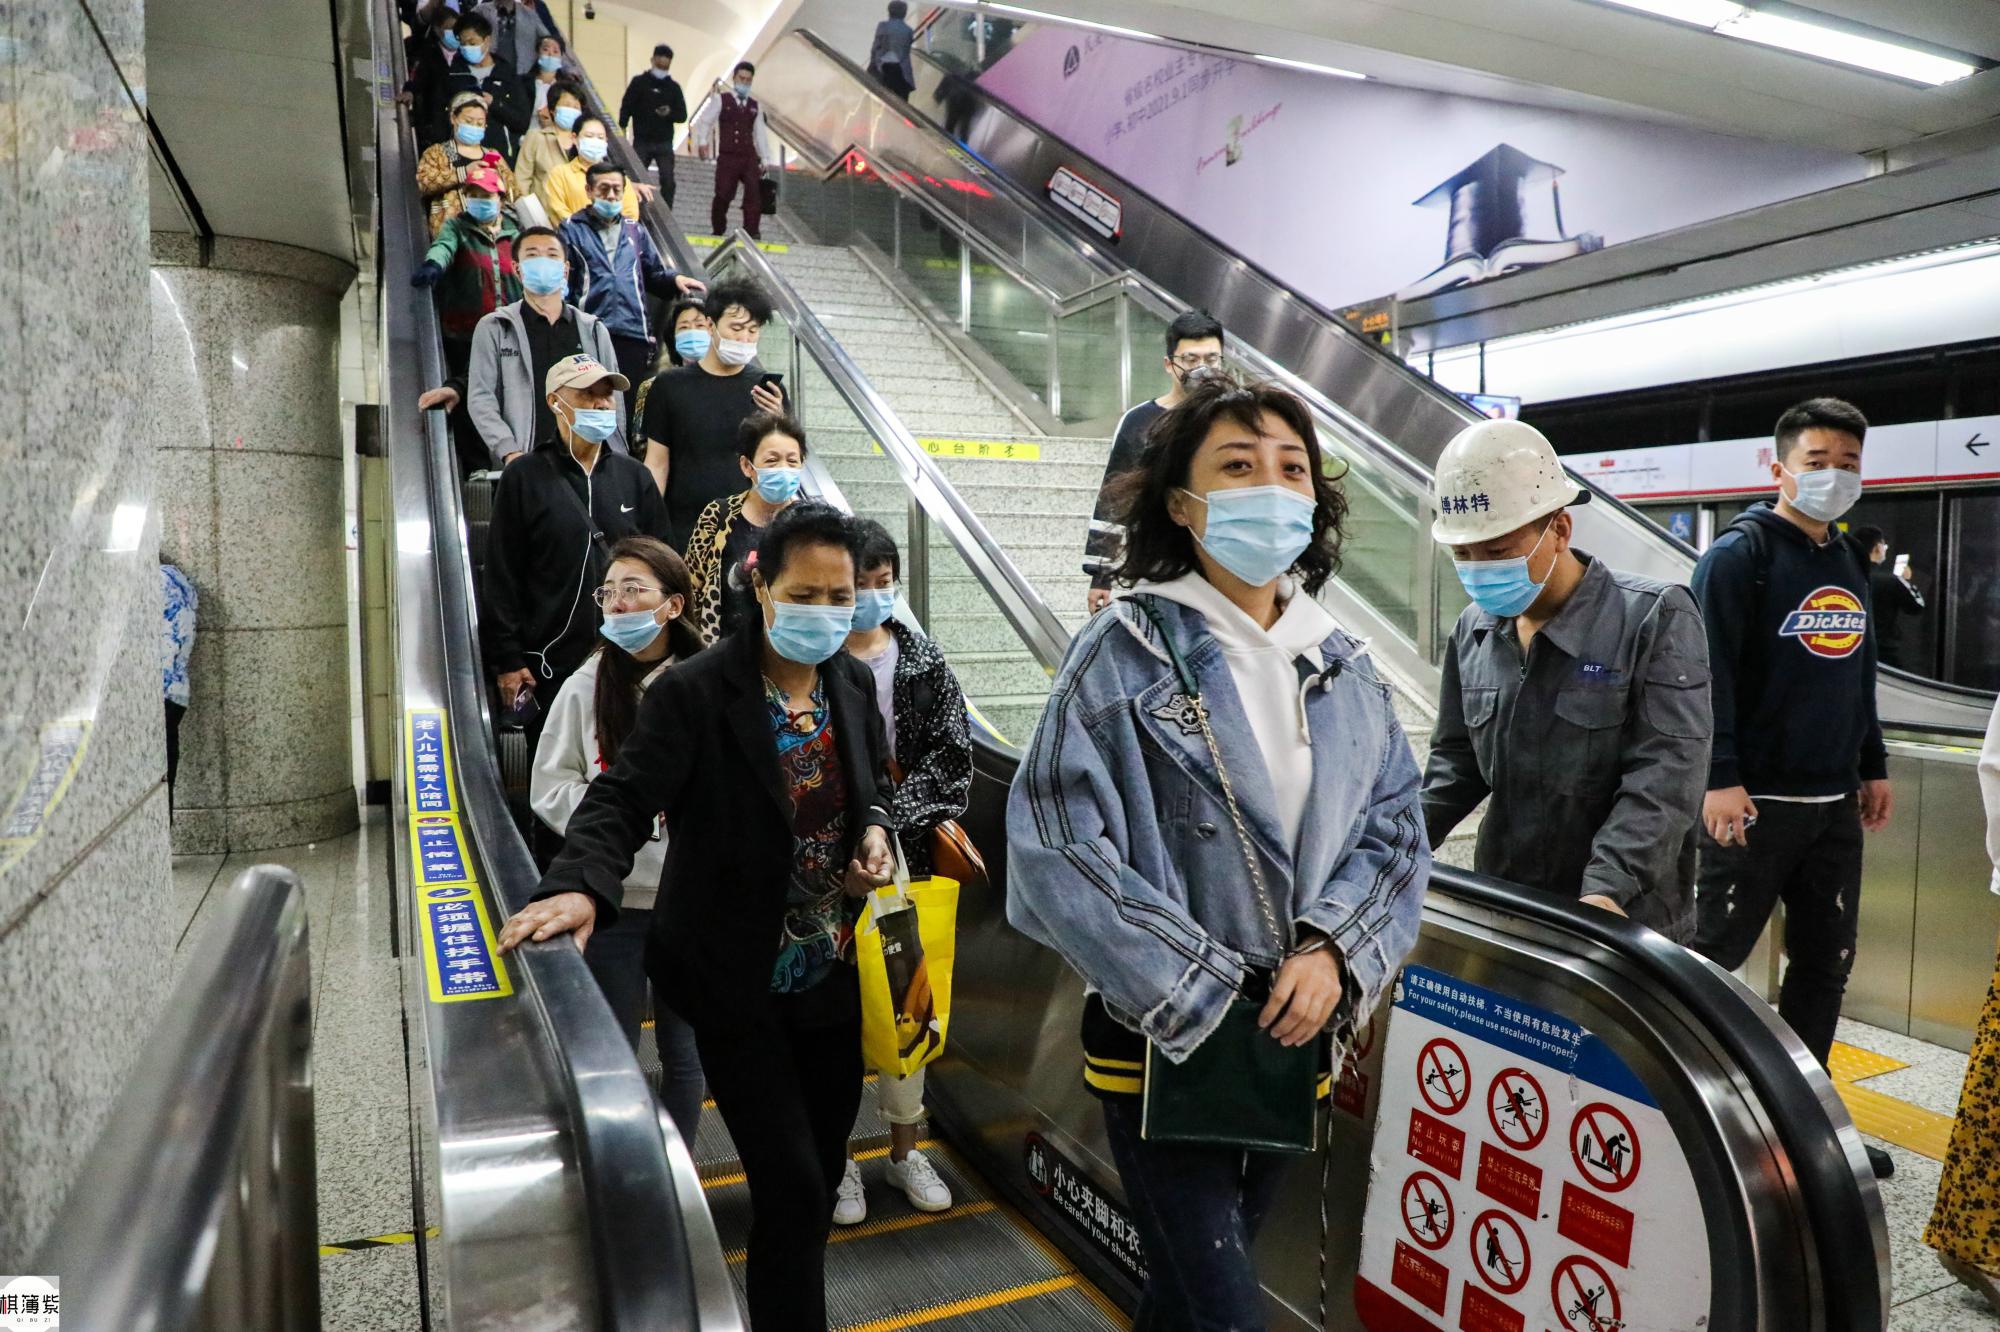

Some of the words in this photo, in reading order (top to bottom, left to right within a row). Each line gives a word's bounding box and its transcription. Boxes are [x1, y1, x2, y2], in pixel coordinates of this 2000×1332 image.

[1441, 492, 1490, 515] 博林特
[1793, 614, 1865, 630] Dickies
[1583, 664, 1602, 673] BLT
[437, 902, 488, 984] 必须握住扶手带
[1408, 989, 1420, 1000] For
[1420, 994, 1436, 1007] your
[1485, 1019, 1499, 1031] use
[1500, 1023, 1541, 1047] escalators
[1411, 1135, 1423, 1148] No
[1053, 1186, 1063, 1205] Be
[1064, 1200, 1090, 1230] careful
[1091, 1224, 1110, 1247] your
[1111, 1242, 1137, 1272] shoes
[1138, 1266, 1150, 1280] an
[1054, 1163, 1147, 1265] 小心夹脚和衣
